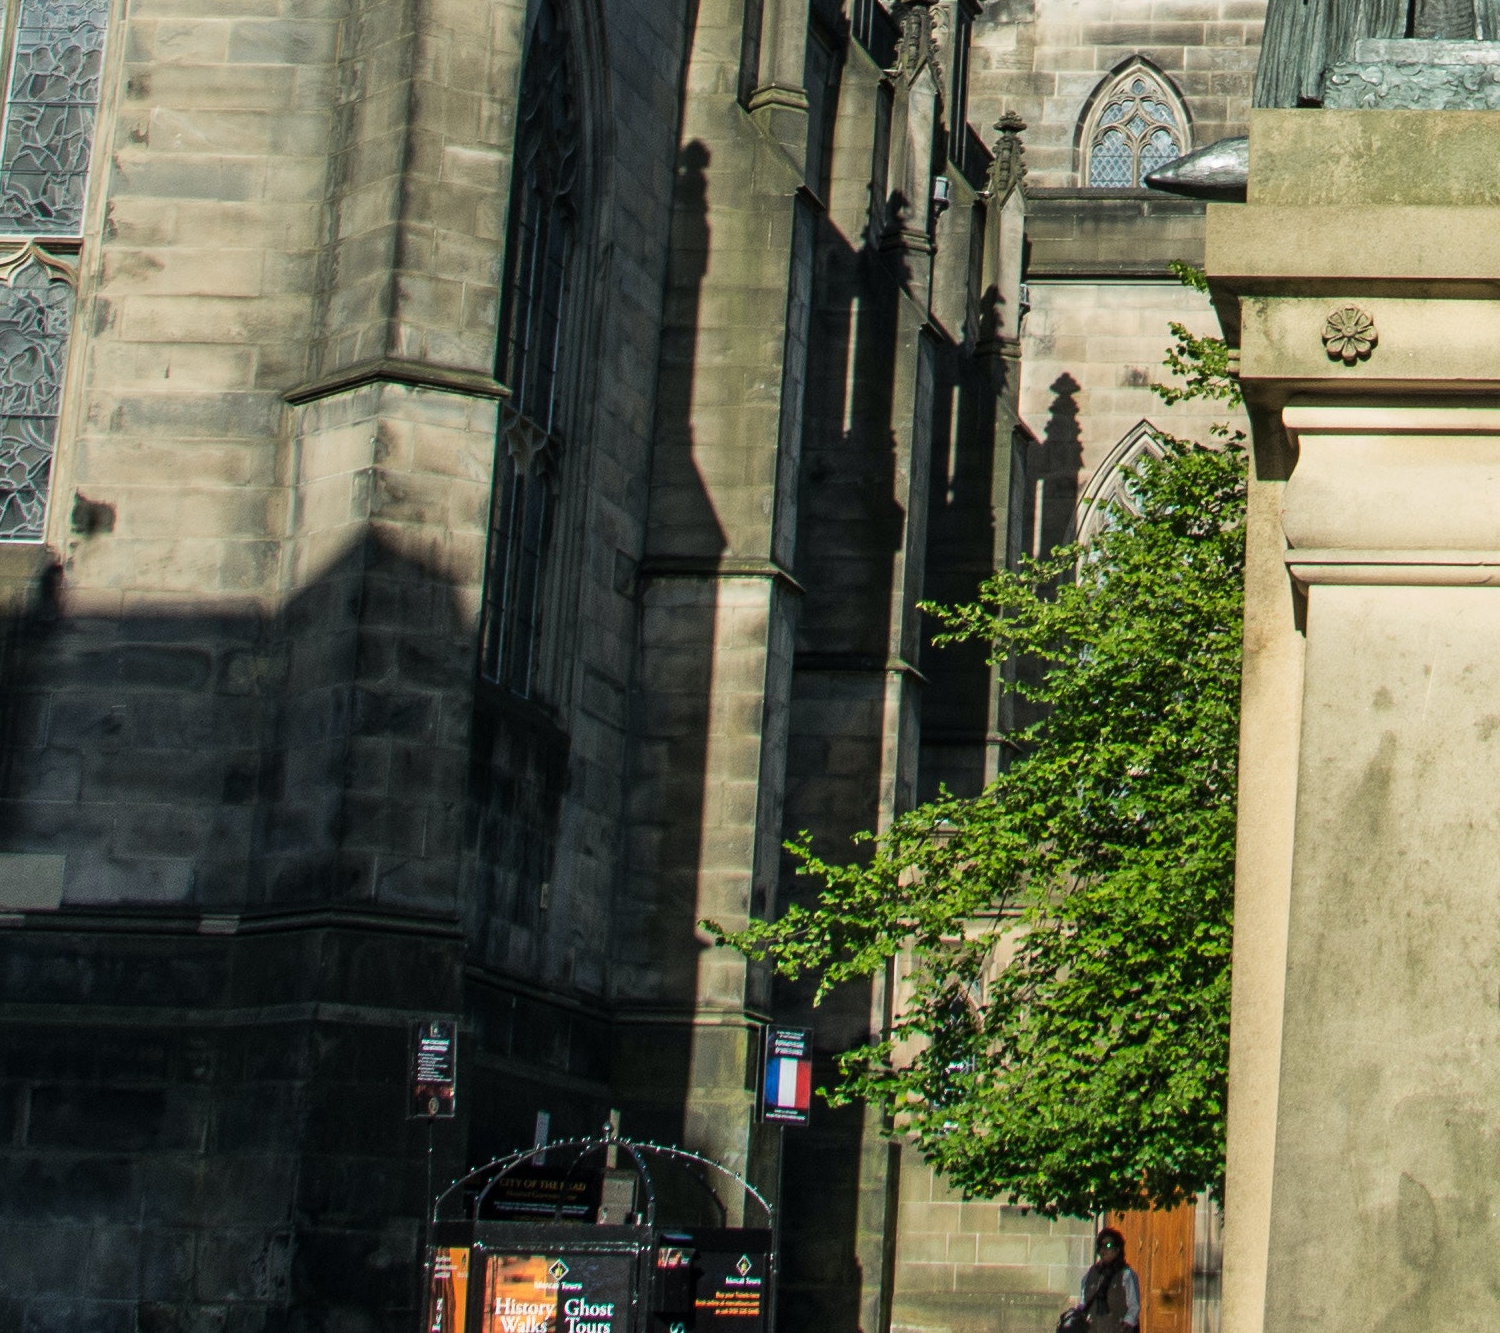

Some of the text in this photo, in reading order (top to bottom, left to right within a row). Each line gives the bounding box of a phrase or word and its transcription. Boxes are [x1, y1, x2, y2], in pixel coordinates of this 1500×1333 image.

[523, 1179, 537, 1189] OF
[540, 1180, 558, 1191] THE
[494, 1297, 557, 1319] History
[564, 1298, 614, 1318] Ghost
[500, 1316, 548, 1333] Walks
[564, 1317, 611, 1333] Tours
